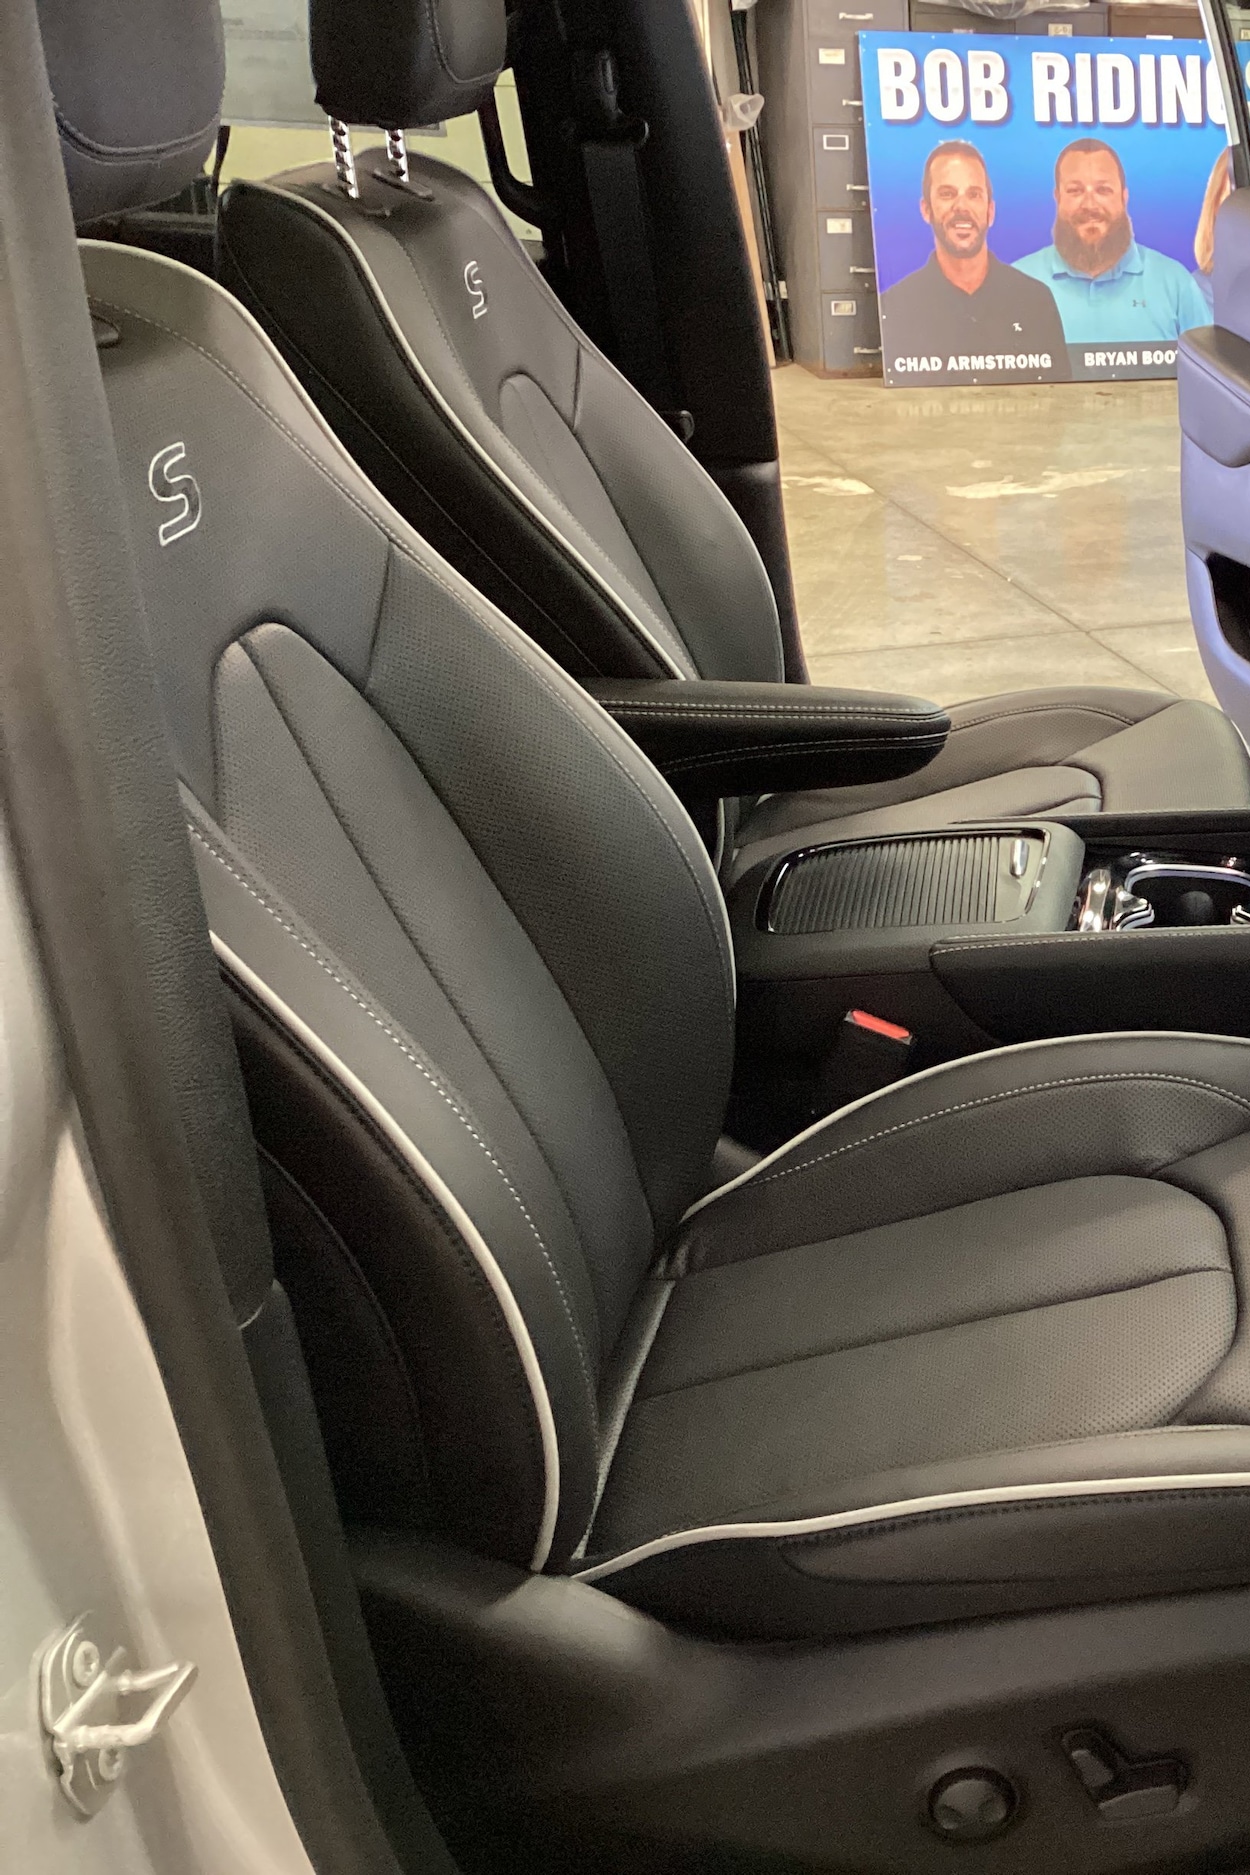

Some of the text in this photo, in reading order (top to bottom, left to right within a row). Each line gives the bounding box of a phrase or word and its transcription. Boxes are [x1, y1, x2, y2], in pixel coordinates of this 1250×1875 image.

[876, 48, 1008, 122] BOB
[894, 354, 1052, 371] CHAD ARMSTRONG
[1084, 350, 1178, 366] BRYAN BOO
